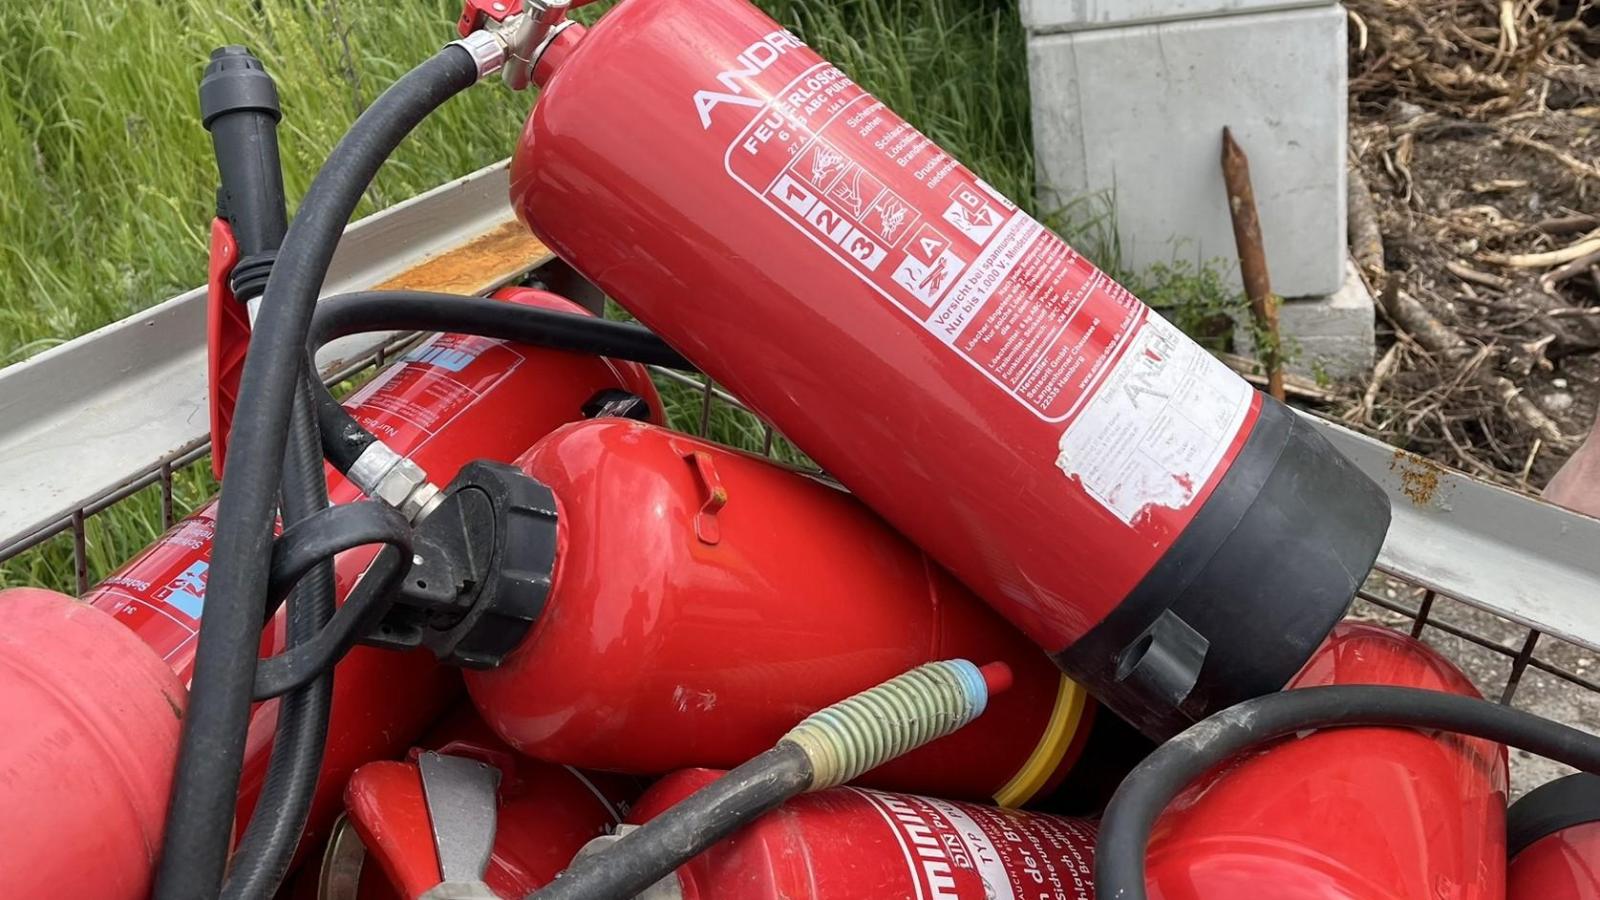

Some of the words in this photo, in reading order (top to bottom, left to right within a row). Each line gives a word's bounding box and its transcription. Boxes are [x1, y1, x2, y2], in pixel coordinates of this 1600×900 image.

[778, 130, 790, 141] 6
[804, 92, 828, 116] ABC
[785, 185, 807, 202] 1
[959, 191, 980, 206] B
[816, 210, 842, 235] 2
[852, 238, 876, 261] 3
[919, 236, 942, 258] A
[934, 283, 972, 326] Vorsicht
[967, 268, 984, 285] bei
[944, 312, 965, 336] Nur
[962, 295, 980, 314] bis
[976, 268, 1001, 295] 1.000
[964, 321, 990, 352] Löscher
[986, 292, 1014, 324] längstens
[982, 327, 997, 344] Nur
[993, 307, 1013, 330] solche
[1000, 319, 1014, 335] die
[1049, 344, 1069, 368] GmbH
[1056, 352, 1085, 388] Hamburg
[943, 833, 971, 868] DIN
[967, 832, 993, 864] TYP
[1018, 847, 1044, 884] der
